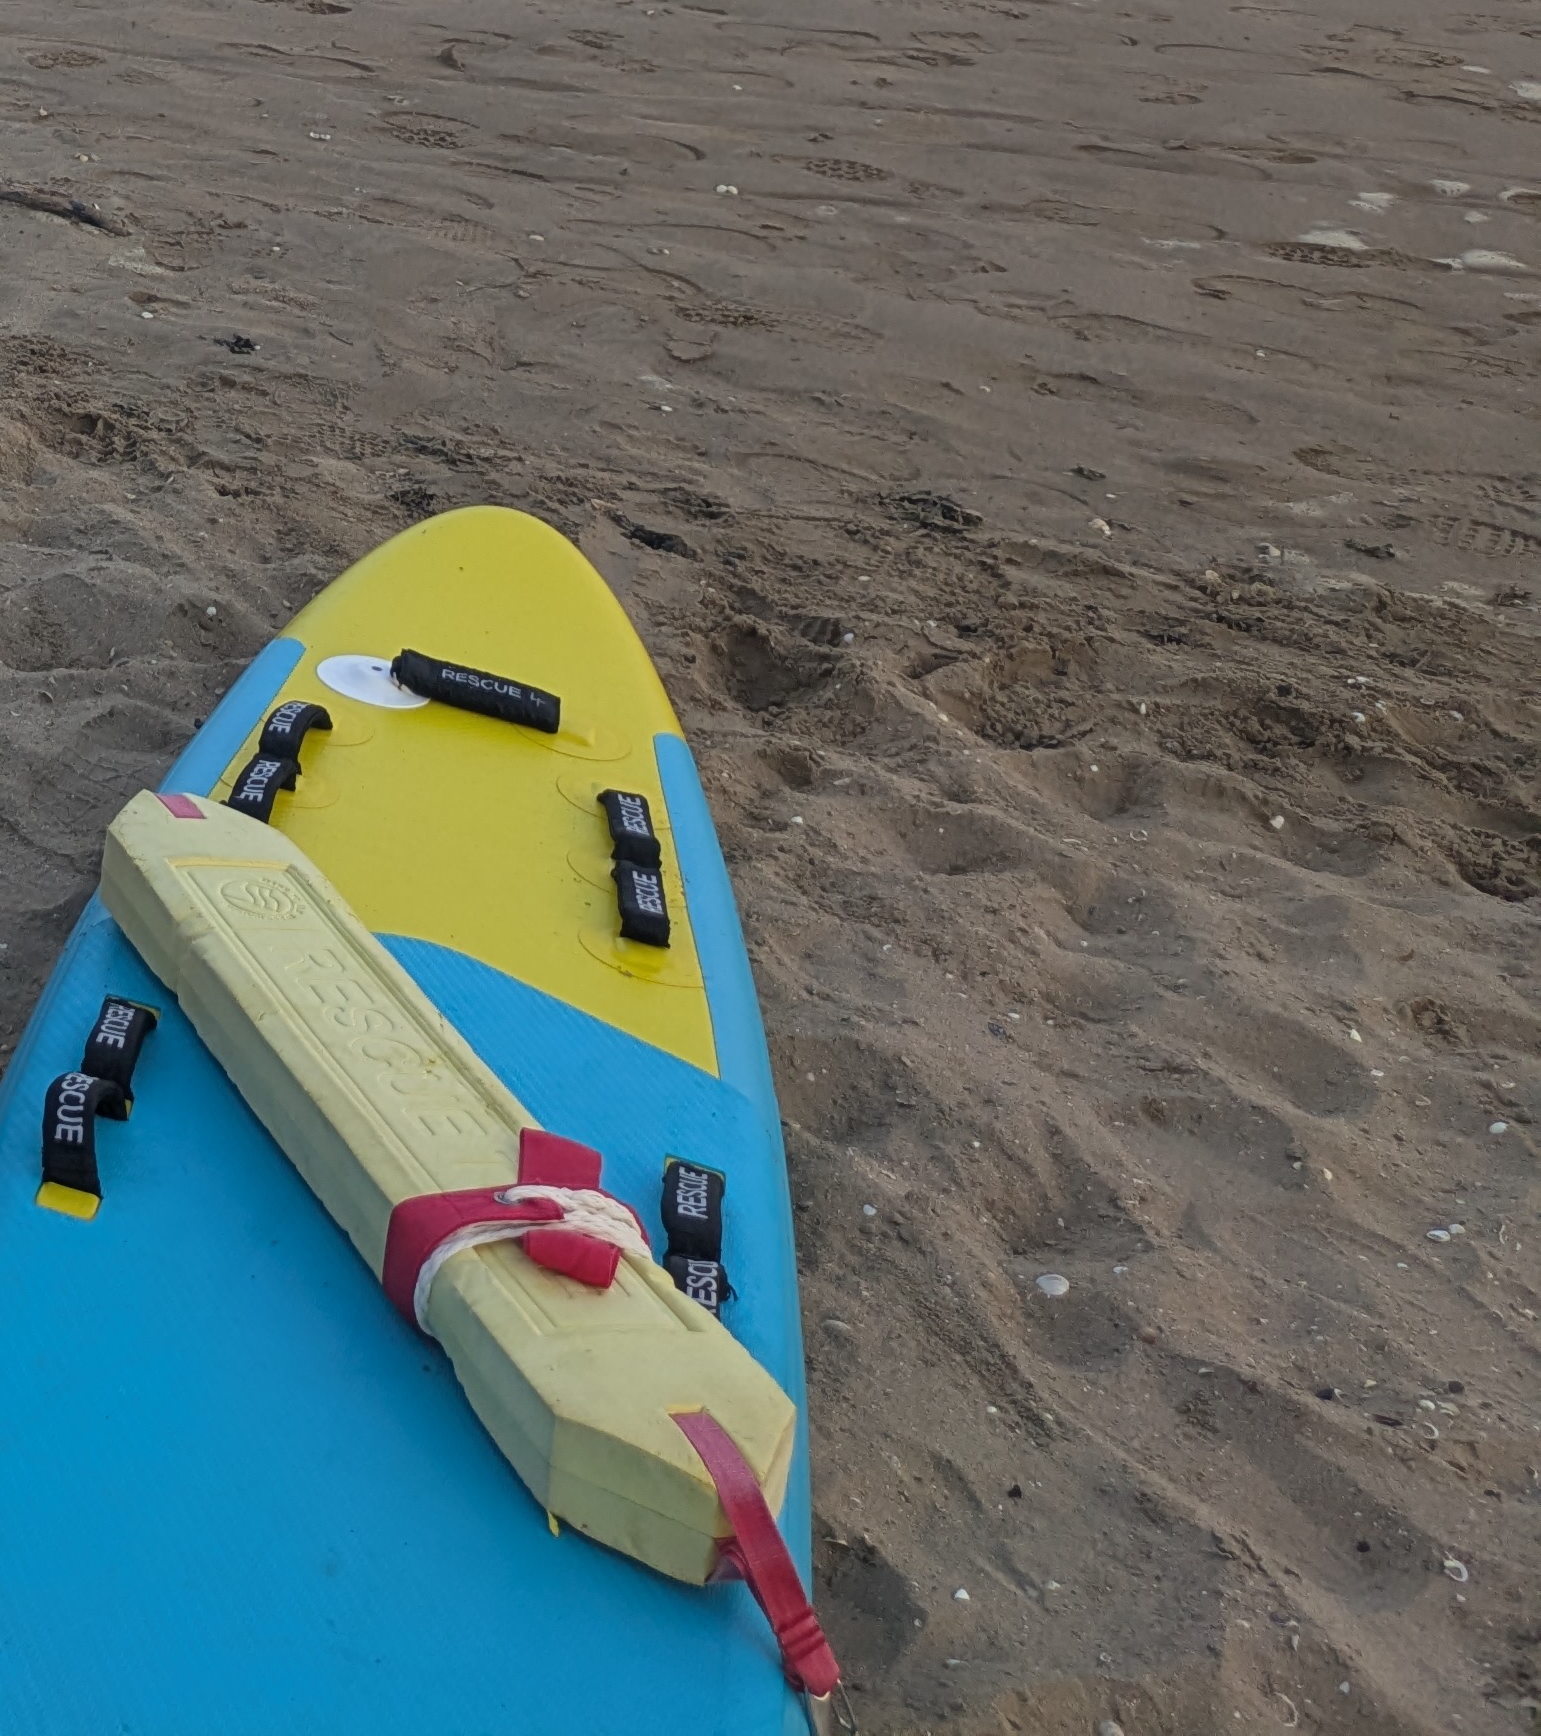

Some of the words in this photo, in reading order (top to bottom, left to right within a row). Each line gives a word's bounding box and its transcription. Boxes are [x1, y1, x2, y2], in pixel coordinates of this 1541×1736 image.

[441, 667, 522, 699] RESCUE
[238, 759, 282, 802] RESCUE
[284, 946, 488, 1137] RESCUE
[53, 1072, 100, 1144] ESCUE
[676, 1165, 709, 1220] RESCUE
[685, 1258, 719, 1314] ESCU
